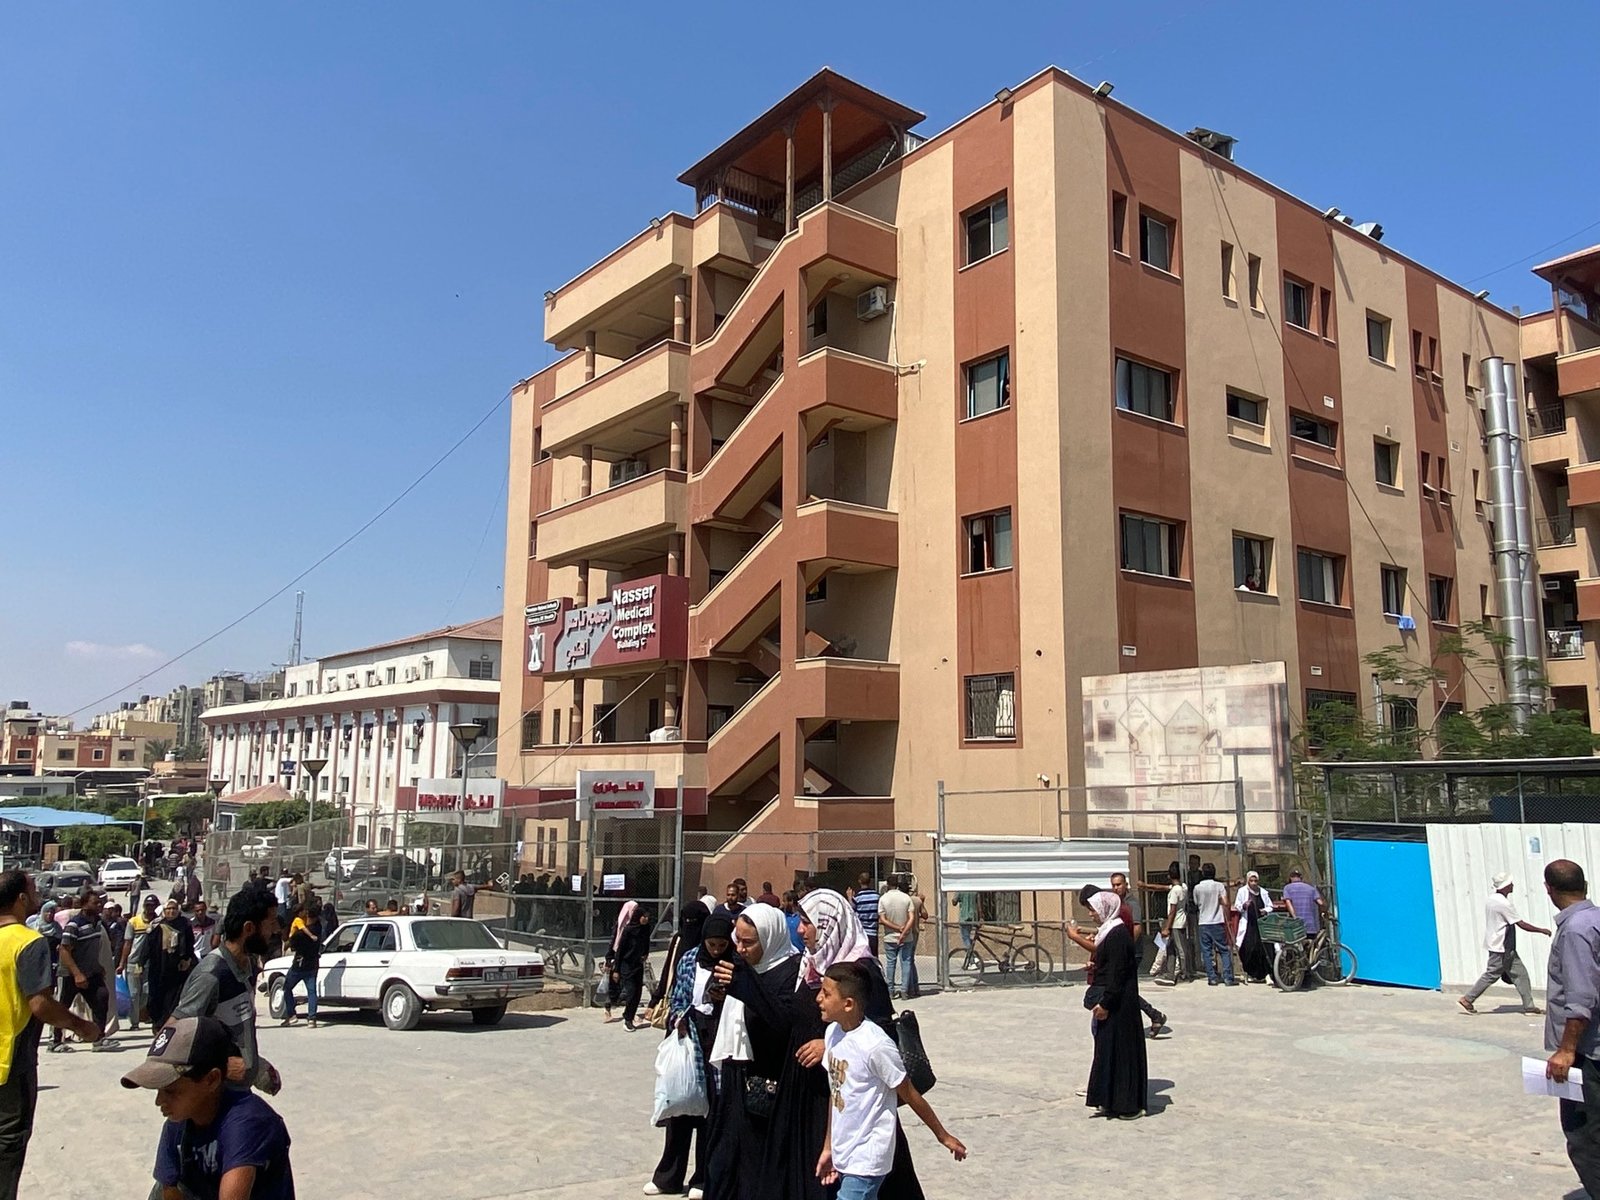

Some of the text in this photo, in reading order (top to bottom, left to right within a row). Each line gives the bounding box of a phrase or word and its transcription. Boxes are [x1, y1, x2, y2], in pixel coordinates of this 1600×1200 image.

[612, 585, 656, 605] Nasser
[617, 603, 653, 621] Medical
[612, 622, 656, 639] Complex
[640, 637, 648, 646] C
